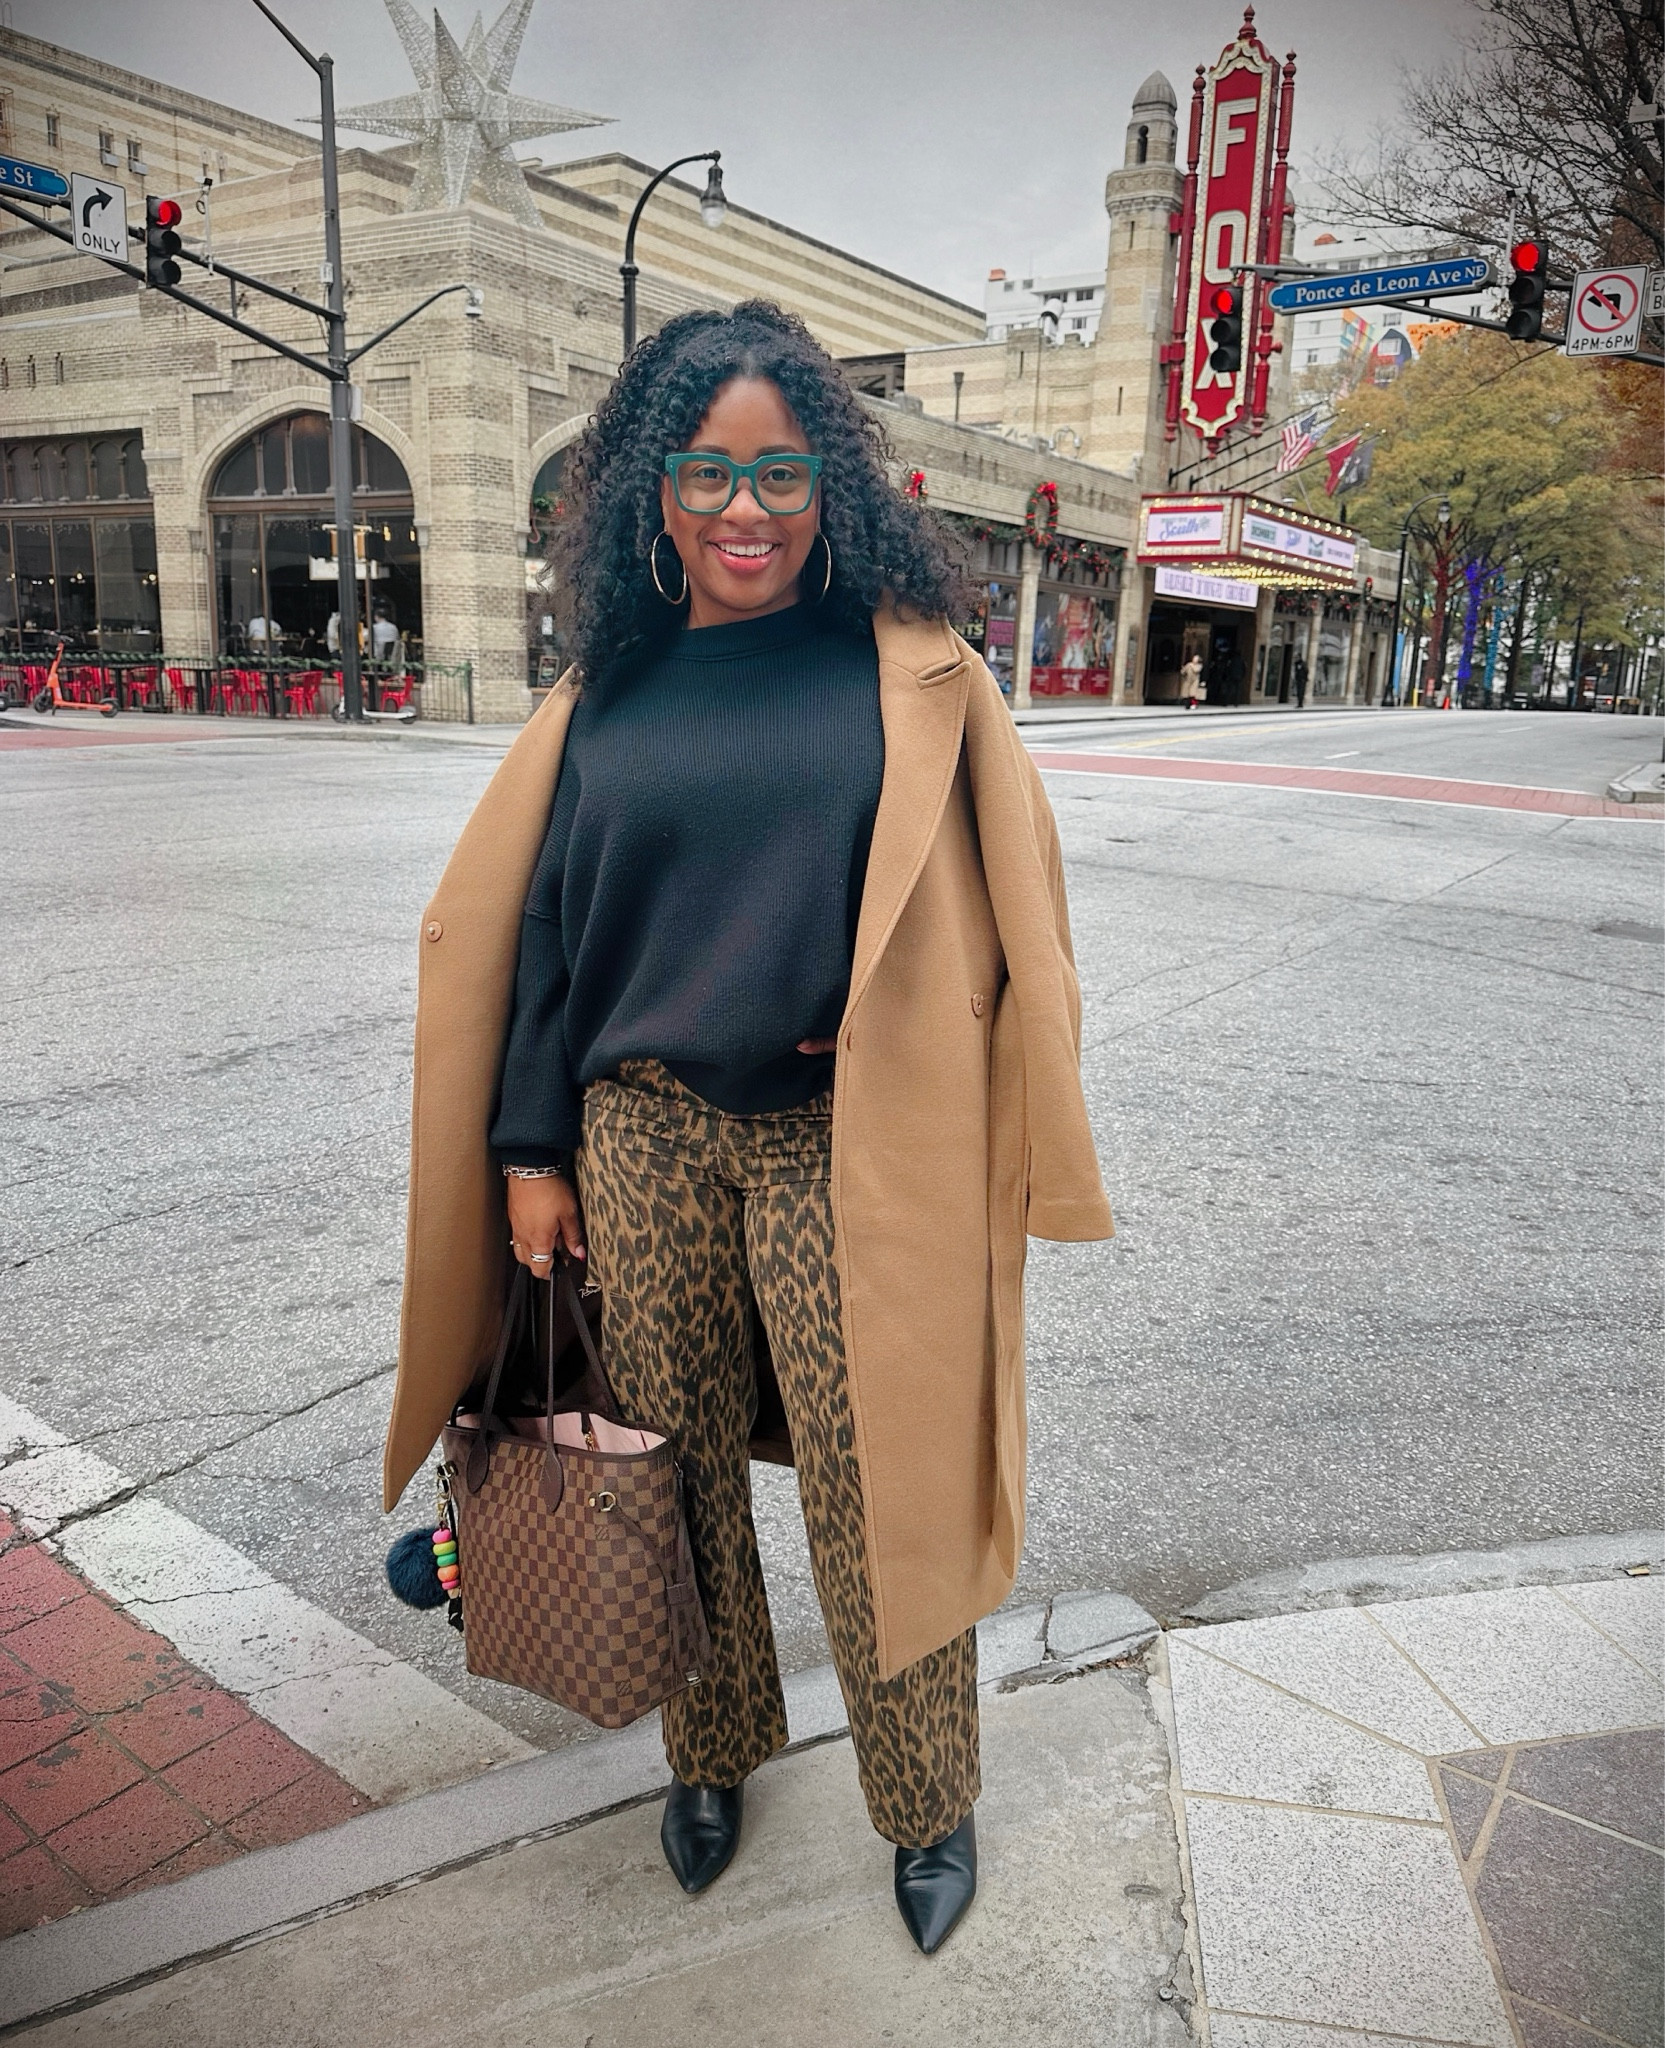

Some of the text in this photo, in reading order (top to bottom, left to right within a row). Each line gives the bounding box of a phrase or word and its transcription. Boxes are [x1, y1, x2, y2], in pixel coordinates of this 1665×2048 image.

[14, 166, 33, 187] St
[82, 232, 120, 254] ONLY
[1195, 97, 1257, 390] FOX
[1295, 265, 1485, 303] Ponce de Leon Ave NE
[1571, 334, 1634, 351] 4PM-6PM
